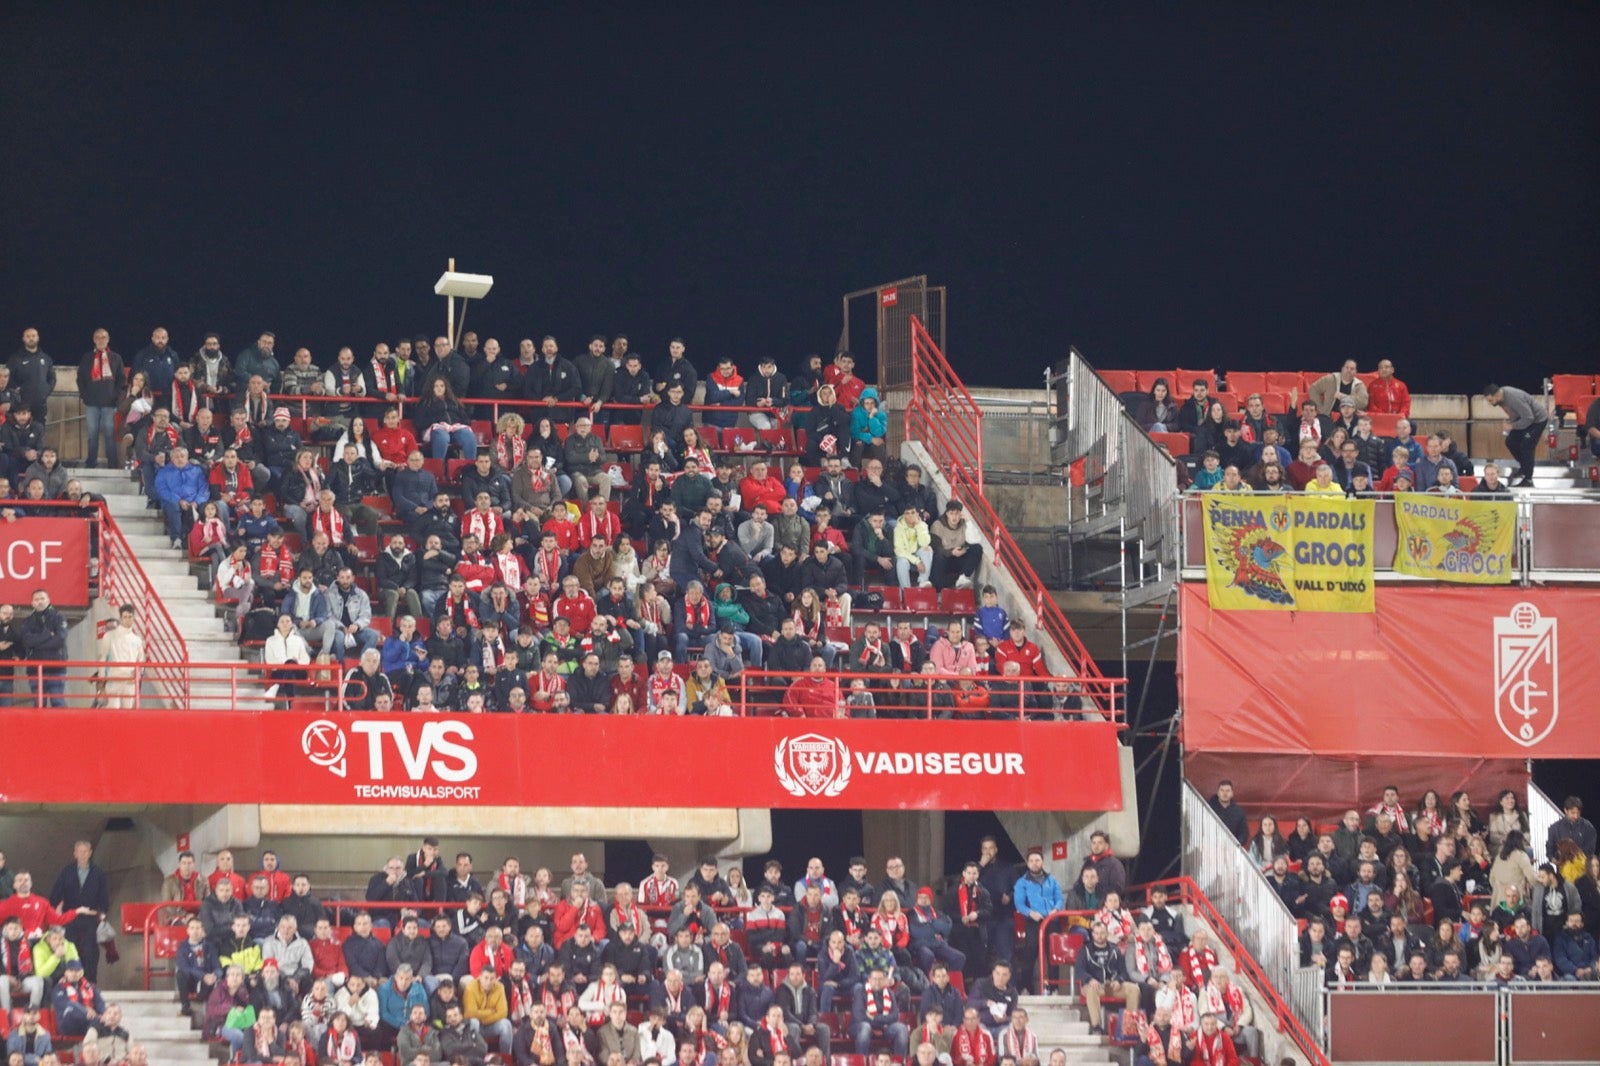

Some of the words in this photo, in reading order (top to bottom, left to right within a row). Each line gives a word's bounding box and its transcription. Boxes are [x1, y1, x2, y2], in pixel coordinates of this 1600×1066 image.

[1211, 509, 1266, 528] PENYA
[1294, 510, 1366, 530] PARDALS
[1403, 502, 1459, 521] PARDALS
[0, 540, 63, 580] CF
[1294, 541, 1366, 567] GROCS
[1444, 550, 1506, 575] GROCS
[1295, 580, 1324, 591] VALL
[351, 719, 478, 782] TVS
[856, 751, 1025, 775] VADISEGUR
[354, 785, 481, 799] TECHVISUALSPORT
